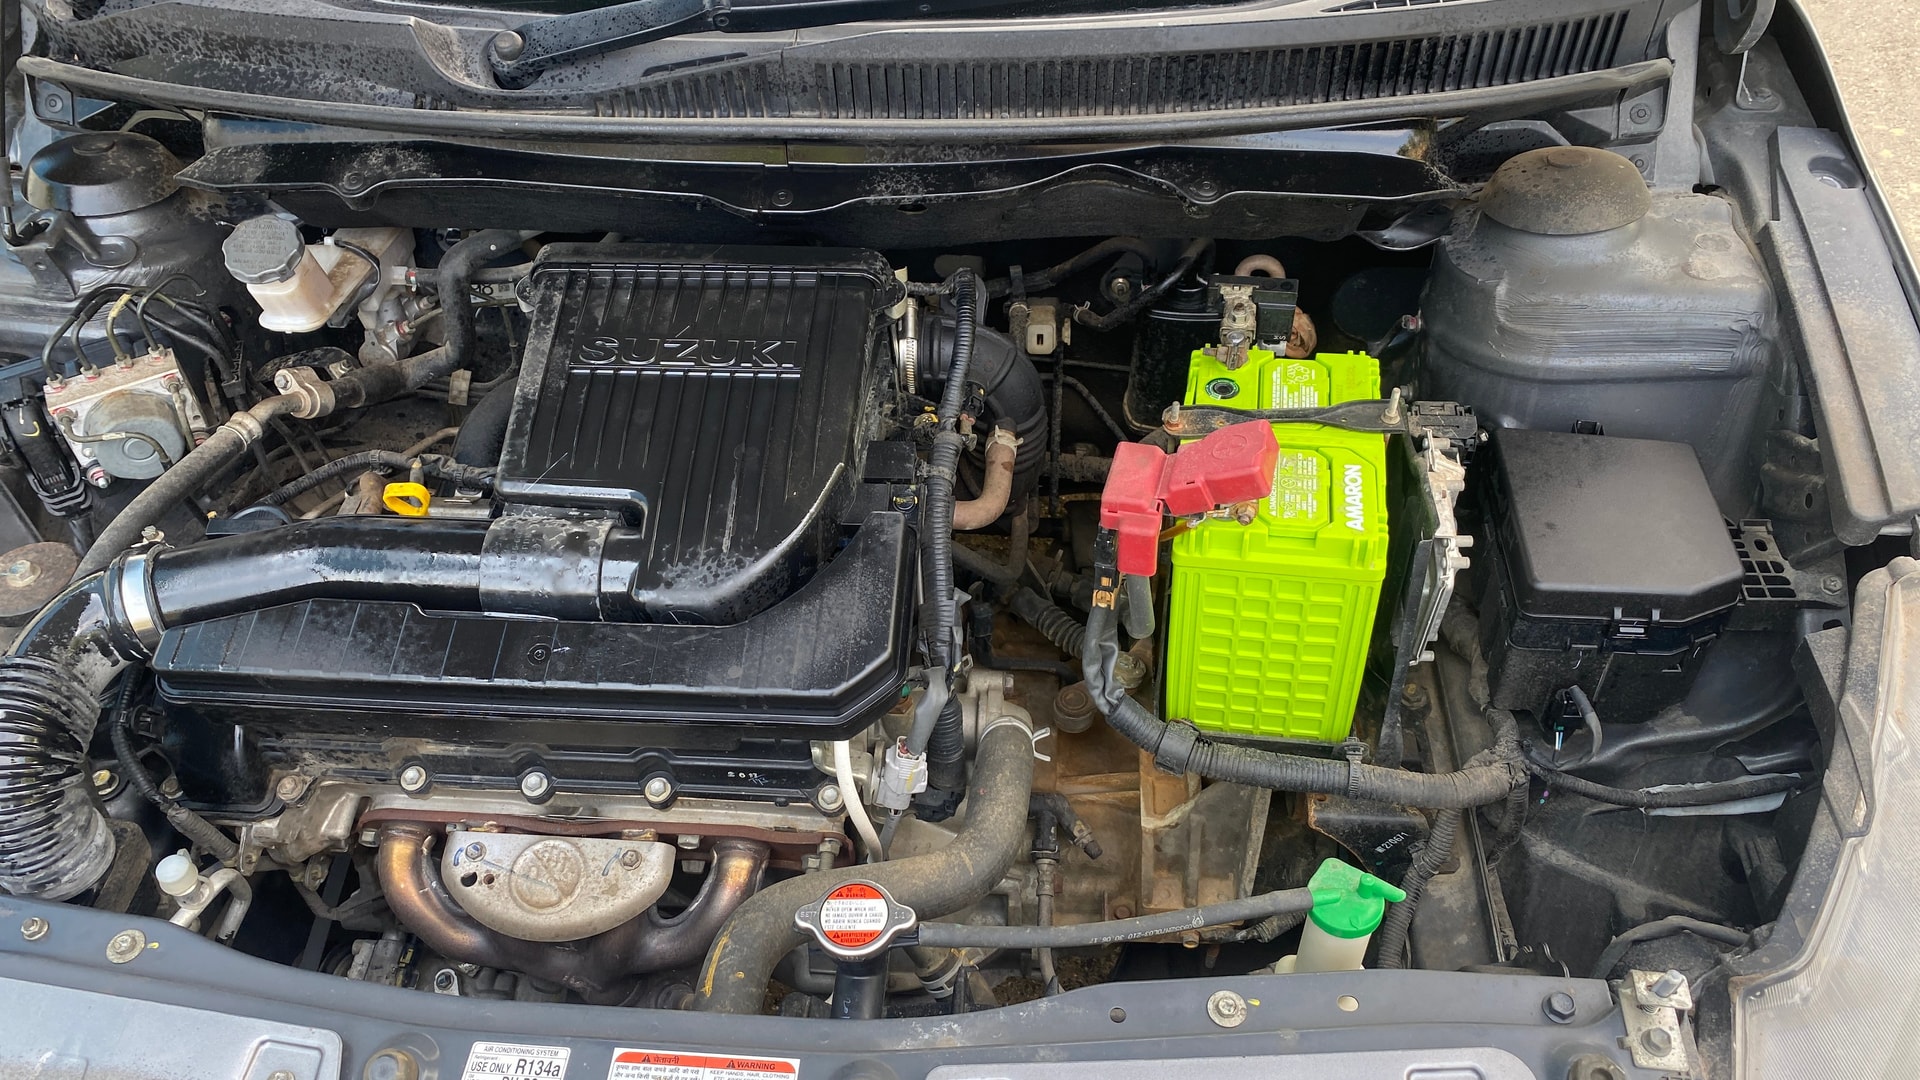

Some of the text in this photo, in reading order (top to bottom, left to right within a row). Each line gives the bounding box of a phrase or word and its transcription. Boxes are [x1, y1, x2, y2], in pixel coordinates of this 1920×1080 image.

[578, 336, 798, 367] SUZUKI
[1344, 464, 1364, 532] AMARON
[494, 1046, 535, 1055] CONDITIONING
[470, 1058, 561, 1077] USE ONLY R134a
[737, 1061, 776, 1070] WARNING
